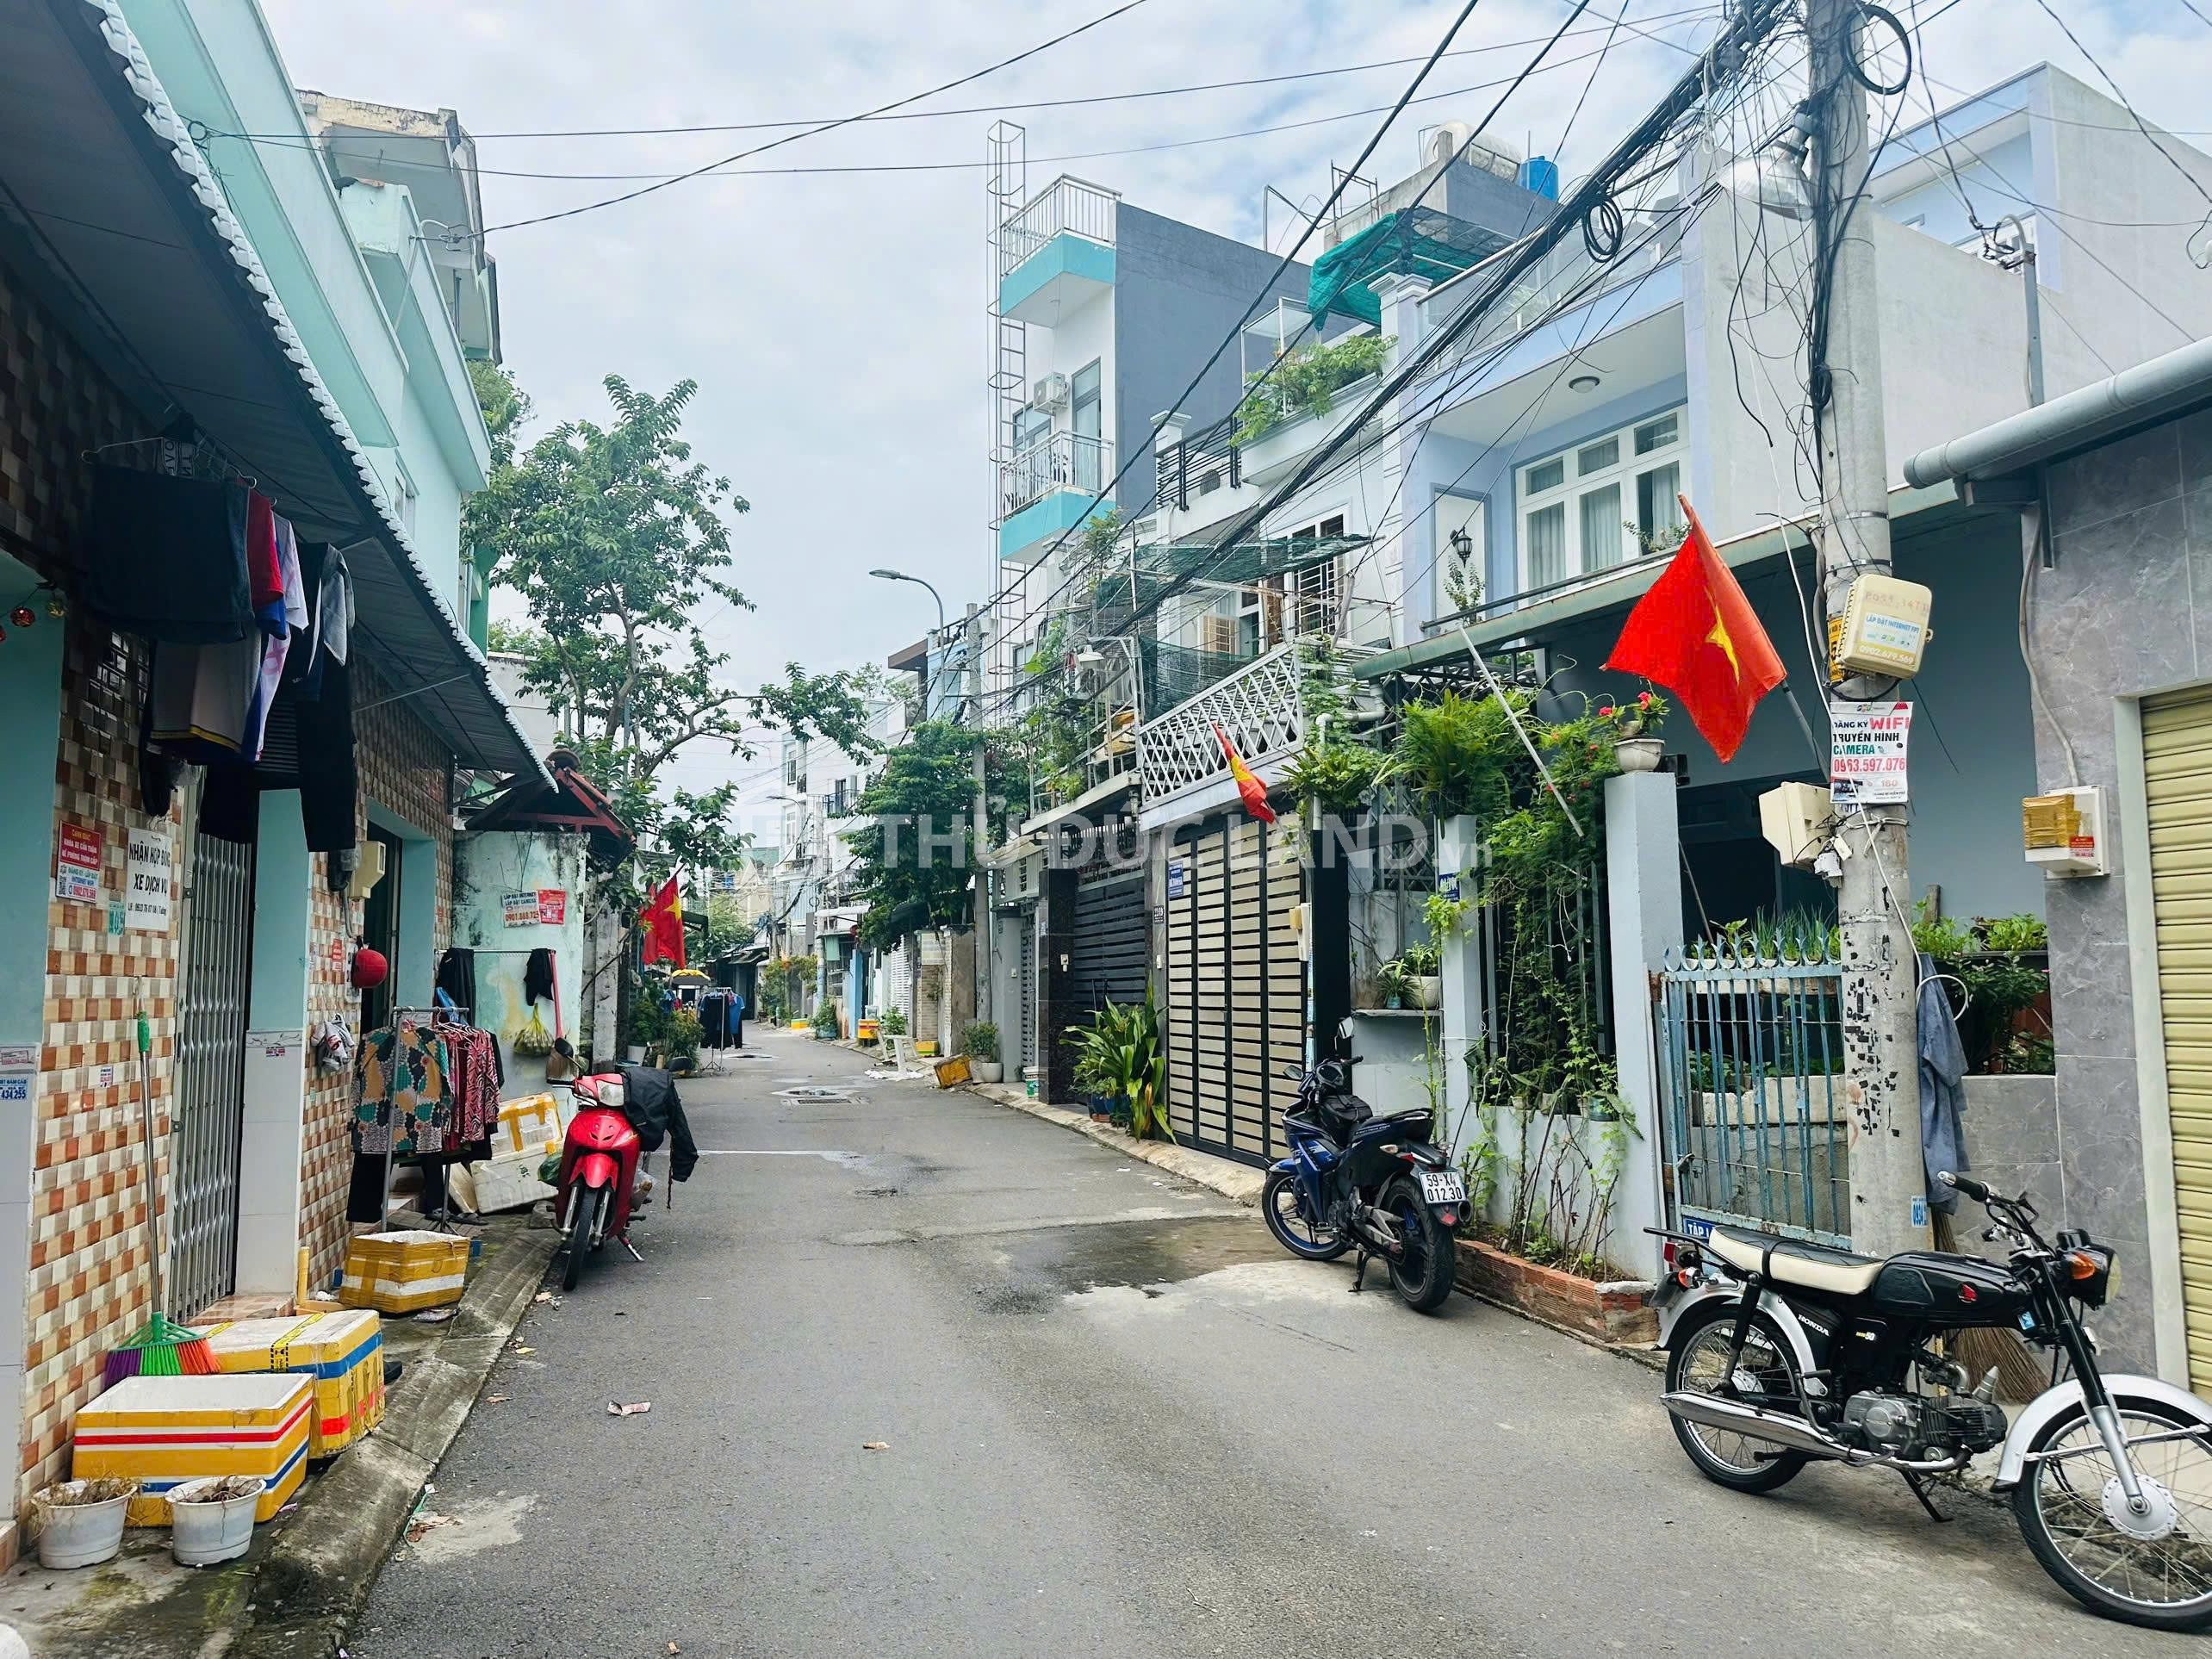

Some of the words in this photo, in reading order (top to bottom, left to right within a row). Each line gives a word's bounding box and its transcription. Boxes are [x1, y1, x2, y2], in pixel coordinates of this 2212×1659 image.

[1869, 717, 1910, 730] WIFI
[1834, 758, 1905, 772] 0963.597.076
[128, 841, 149, 865] NHẬN
[134, 873, 144, 891] XE
[145, 875, 159, 896] DỊCH
[1426, 1173, 1457, 1188] 59-X4
[1426, 1187, 1463, 1202] 012.30
[1798, 1314, 1830, 1337] HONDA
